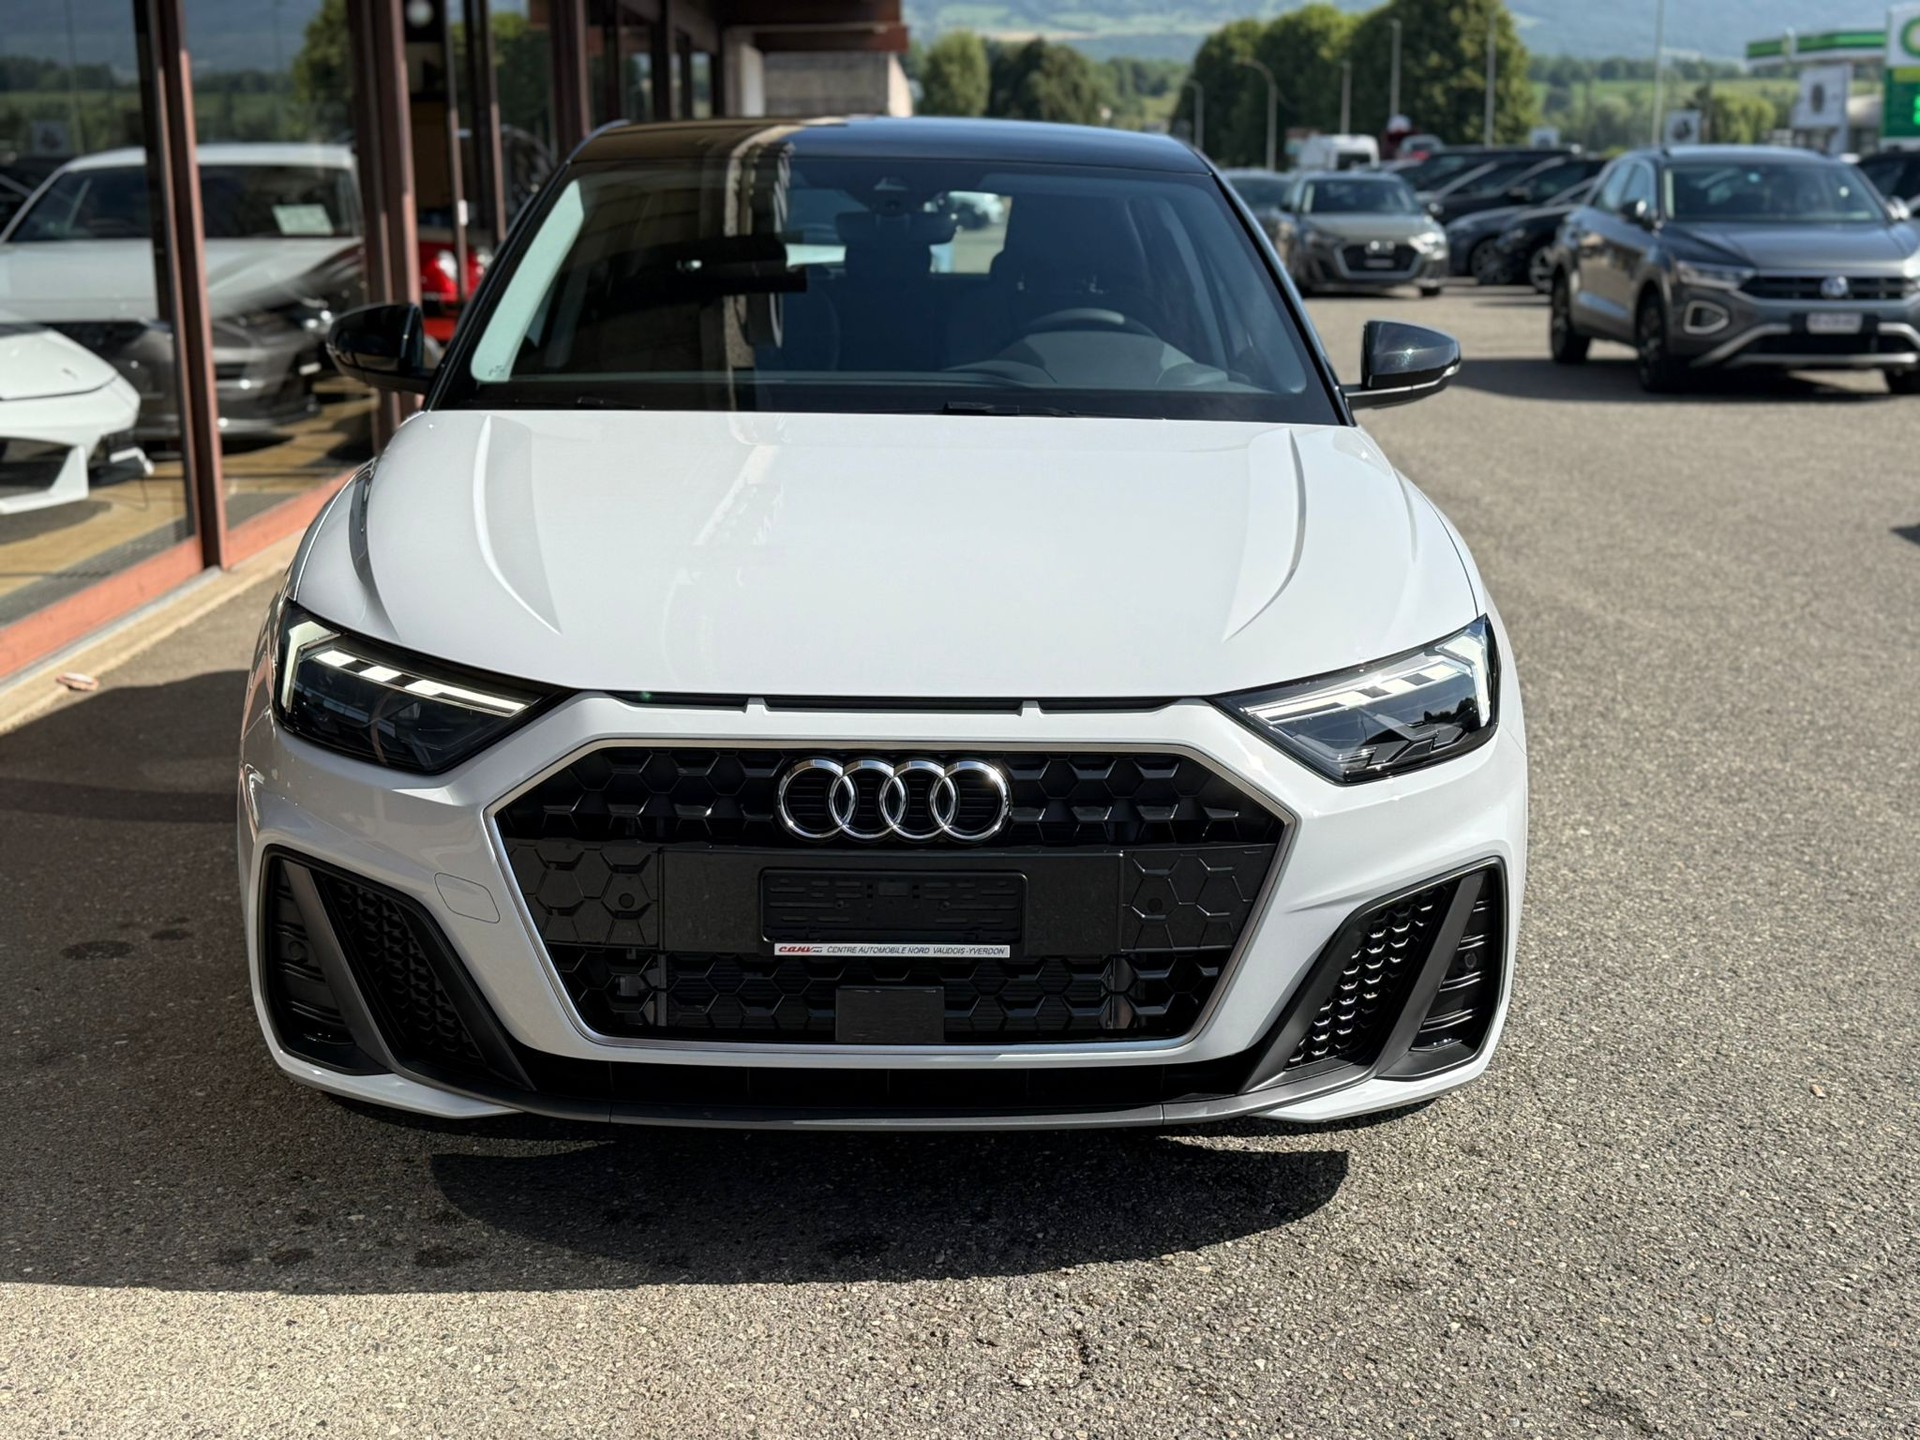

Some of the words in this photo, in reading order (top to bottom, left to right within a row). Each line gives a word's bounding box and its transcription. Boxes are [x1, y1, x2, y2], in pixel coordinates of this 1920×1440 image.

[826, 945, 858, 954] CENTRE
[858, 946, 907, 955] AUTOMOBILE
[907, 946, 930, 955] NORD
